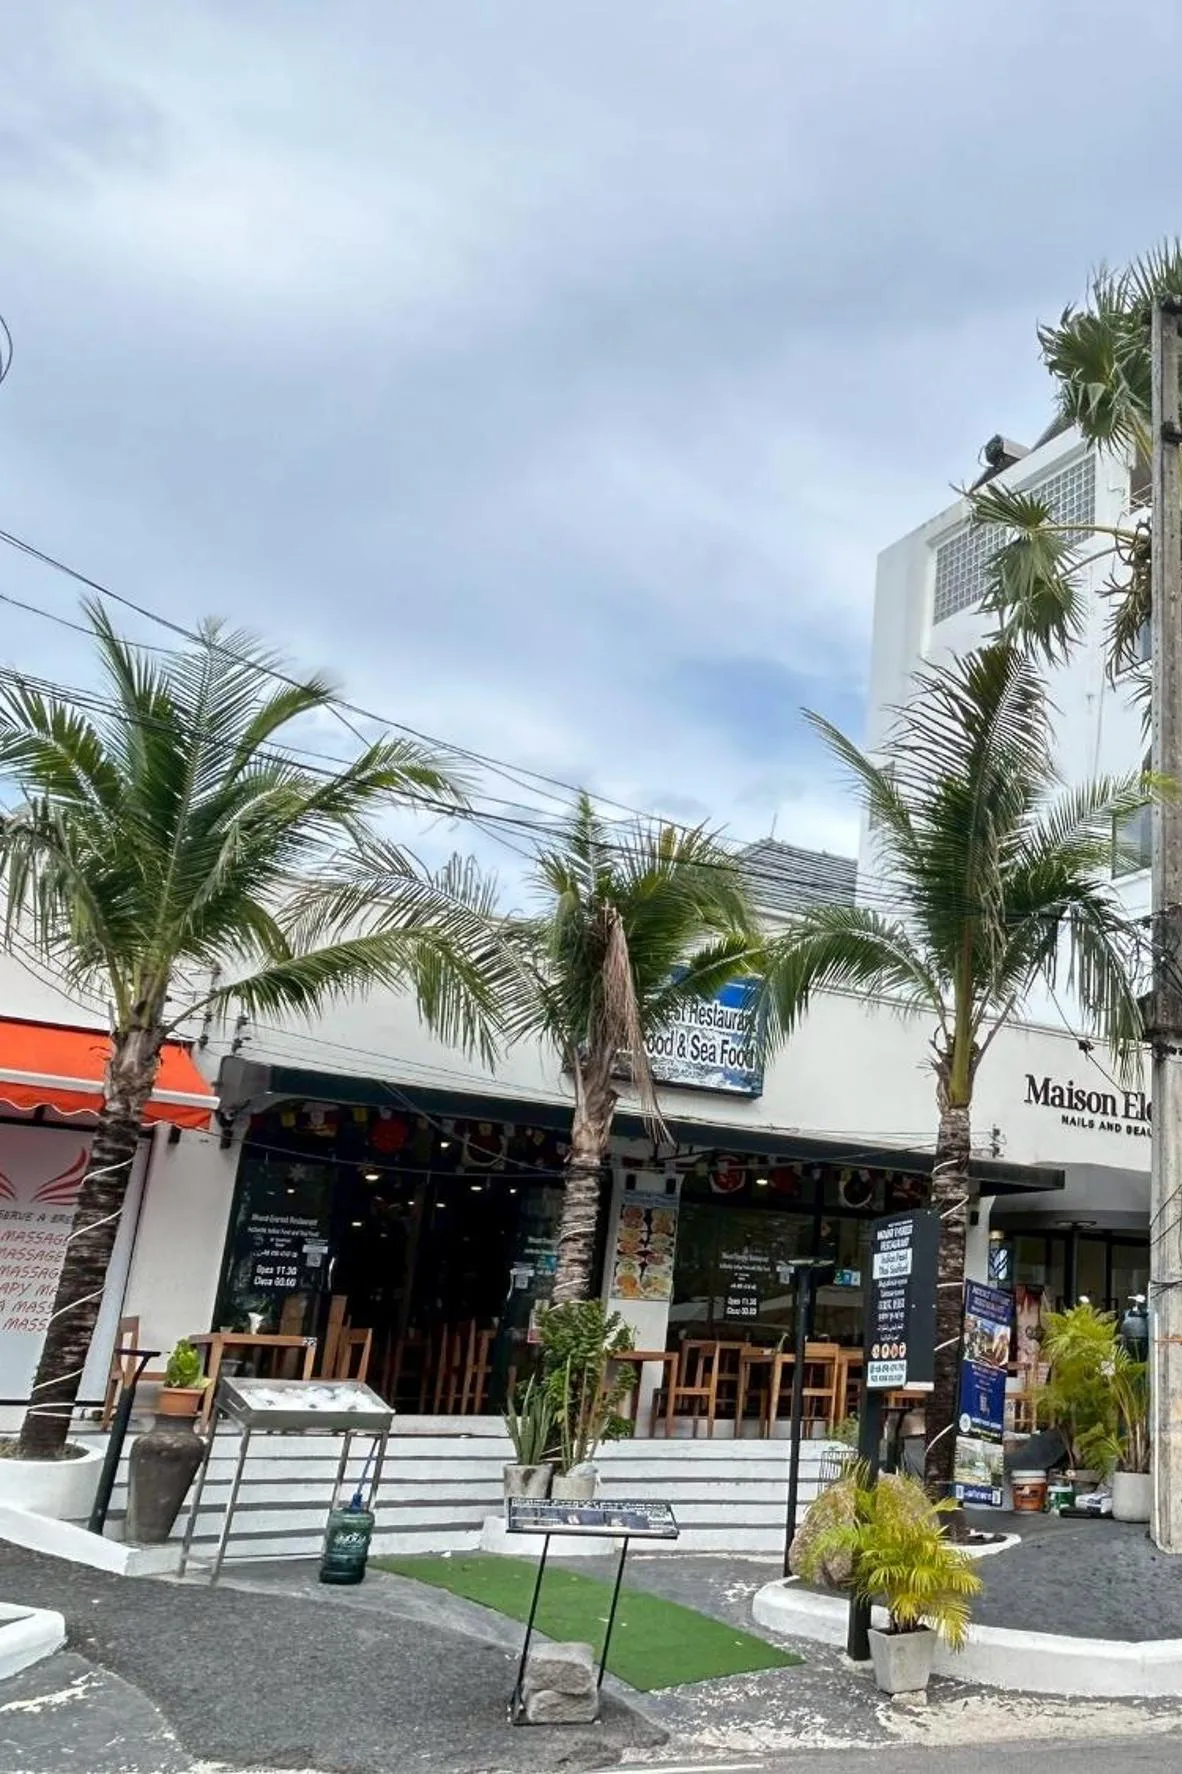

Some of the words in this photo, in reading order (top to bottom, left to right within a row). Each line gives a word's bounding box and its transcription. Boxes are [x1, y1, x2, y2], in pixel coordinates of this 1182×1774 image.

[689, 1000, 757, 1032] Restaura
[677, 1033, 688, 1058] &
[690, 1034, 717, 1063] Sea
[720, 1039, 755, 1070] Food
[1024, 1074, 1118, 1118] Maison
[1061, 1115, 1095, 1129] NAILS
[1099, 1121, 1122, 1133] AND
